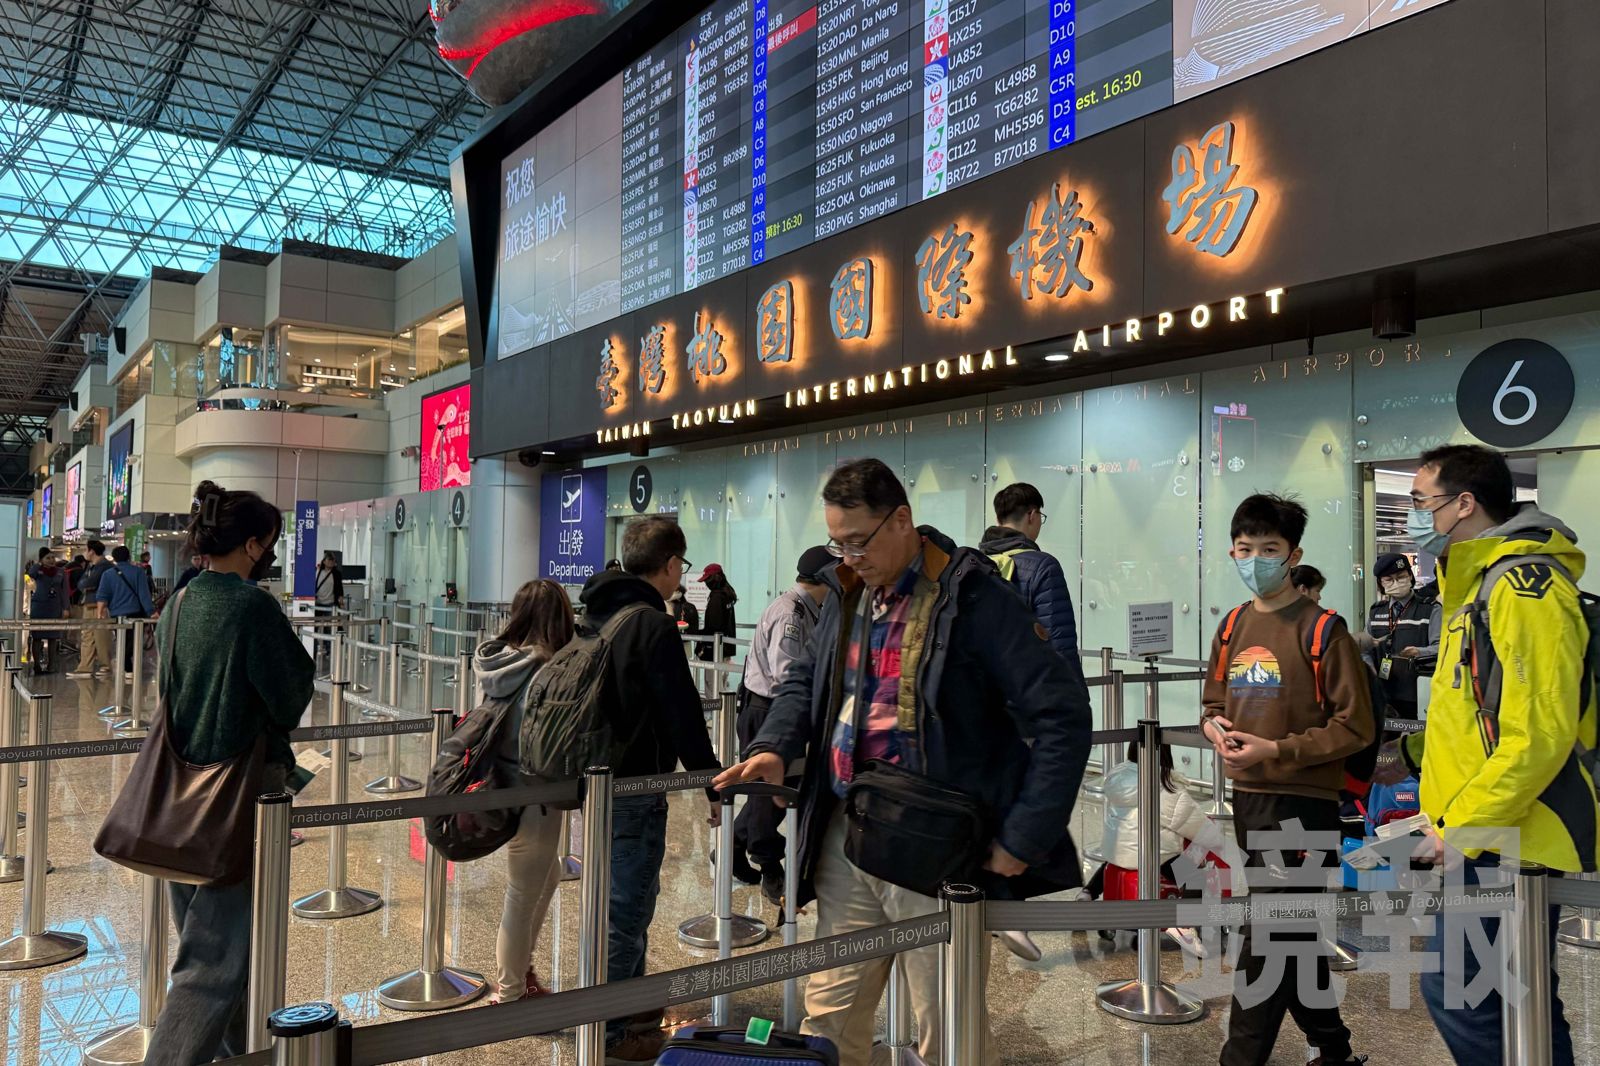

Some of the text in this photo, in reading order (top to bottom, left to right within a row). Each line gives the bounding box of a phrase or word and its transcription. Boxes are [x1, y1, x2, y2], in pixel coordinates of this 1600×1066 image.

[724, 1, 748, 26] BR2201
[756, 6, 766, 22] D8
[818, 16, 839, 38] 15:20
[840, 4, 856, 24] NRT
[756, 25, 764, 40] D1
[817, 36, 839, 58] 15:20
[839, 24, 858, 45] DAD
[862, 17, 873, 31] Da
[875, 2, 898, 23] Nang
[756, 44, 765, 58] C6
[816, 0, 976, 98] 15:35 PEK Beijing CI517
[817, 27, 889, 78] 15:30 MNL Manila
[756, 62, 764, 76] C7
[816, 19, 982, 118] 15:45 HKG Hong Kong HX255
[816, 0, 1071, 138] 15:50 SFO San Francisco UA852 D6
[753, 80, 767, 96] D5R
[816, 21, 1075, 158] 15:50 NGO Nagoya JL8670 D10
[755, 99, 764, 112] C8
[816, 49, 1070, 178] 16:25 FUK Fukuoka CI116 KL4988 A9
[755, 118, 764, 132] A8
[816, 72, 1075, 198] 16:25 FUK Fukuoka BR102 TG6282 C5R
[755, 136, 764, 150] C5
[816, 70, 1142, 218] 16:25 OKA Okinawa CI122 MH5596 D3 est. 16:30
[506, 156, 535, 208] 祝您
[698, 155, 764, 197] UA852 D6
[752, 172, 766, 188] D10
[815, 124, 1070, 238] 16:30 PVG Shanghai BR722 B77018 C4
[723, 201, 746, 220] KL4988
[754, 193, 764, 206] A9
[504, 192, 566, 262] 旅途愉快
[722, 235, 750, 256] MH5596
[754, 230, 764, 243] D3
[782, 213, 802, 232] 16:30
[723, 218, 747, 238] TG6282
[752, 211, 766, 226] C5R
[722, 256, 746, 273] B77018
[754, 249, 763, 261] C4
[596, 288, 1284, 444] TAIWAN TAOYUAN INTERNATIONAL AIRPORT
[1252, 342, 1452, 383] AIRPOR
[1492, 360, 1538, 426] 6
[636, 474, 645, 503] 5
[454, 500, 461, 518] 4
[296, 519, 304, 556] Departures
[559, 529, 584, 556] 出發
[549, 560, 594, 581] Departures
[395, 721, 424, 731] Taiwan
[1390, 720, 1424, 730] Taoyuan
[47, 742, 118, 756] International
[646, 777, 686, 790] Taoyuan
[356, 807, 402, 820] Airport
[1354, 896, 1404, 912] Taiwan
[1409, 892, 1471, 911] Taoyuan
[668, 920, 949, 1000] 臺灣桃園國際機場 Taiwan Taoyuan
